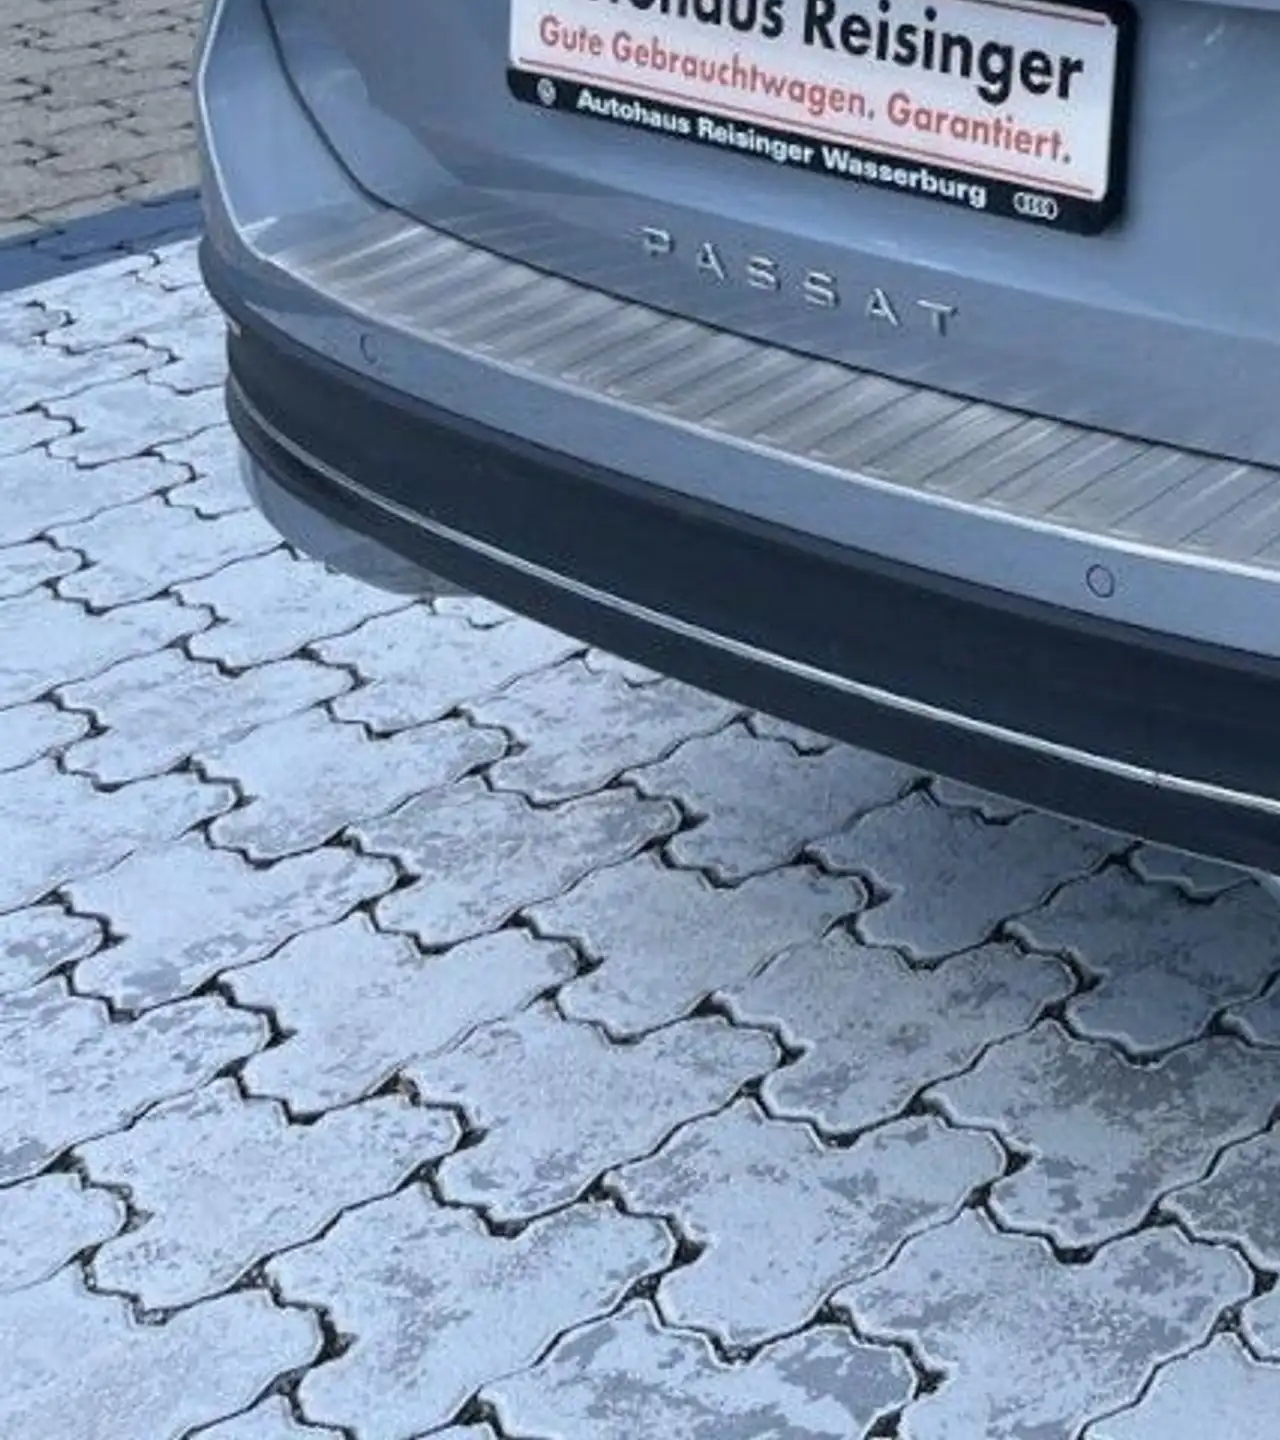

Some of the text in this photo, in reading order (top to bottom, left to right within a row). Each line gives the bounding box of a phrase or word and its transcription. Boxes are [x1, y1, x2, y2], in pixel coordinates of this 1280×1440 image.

[540, 15, 1072, 164] Gute Gebrauchtwagen. Garantiert.
[576, 89, 988, 209] Autohaus Reisinger Wasserburg
[642, 226, 959, 337] PASSAT
